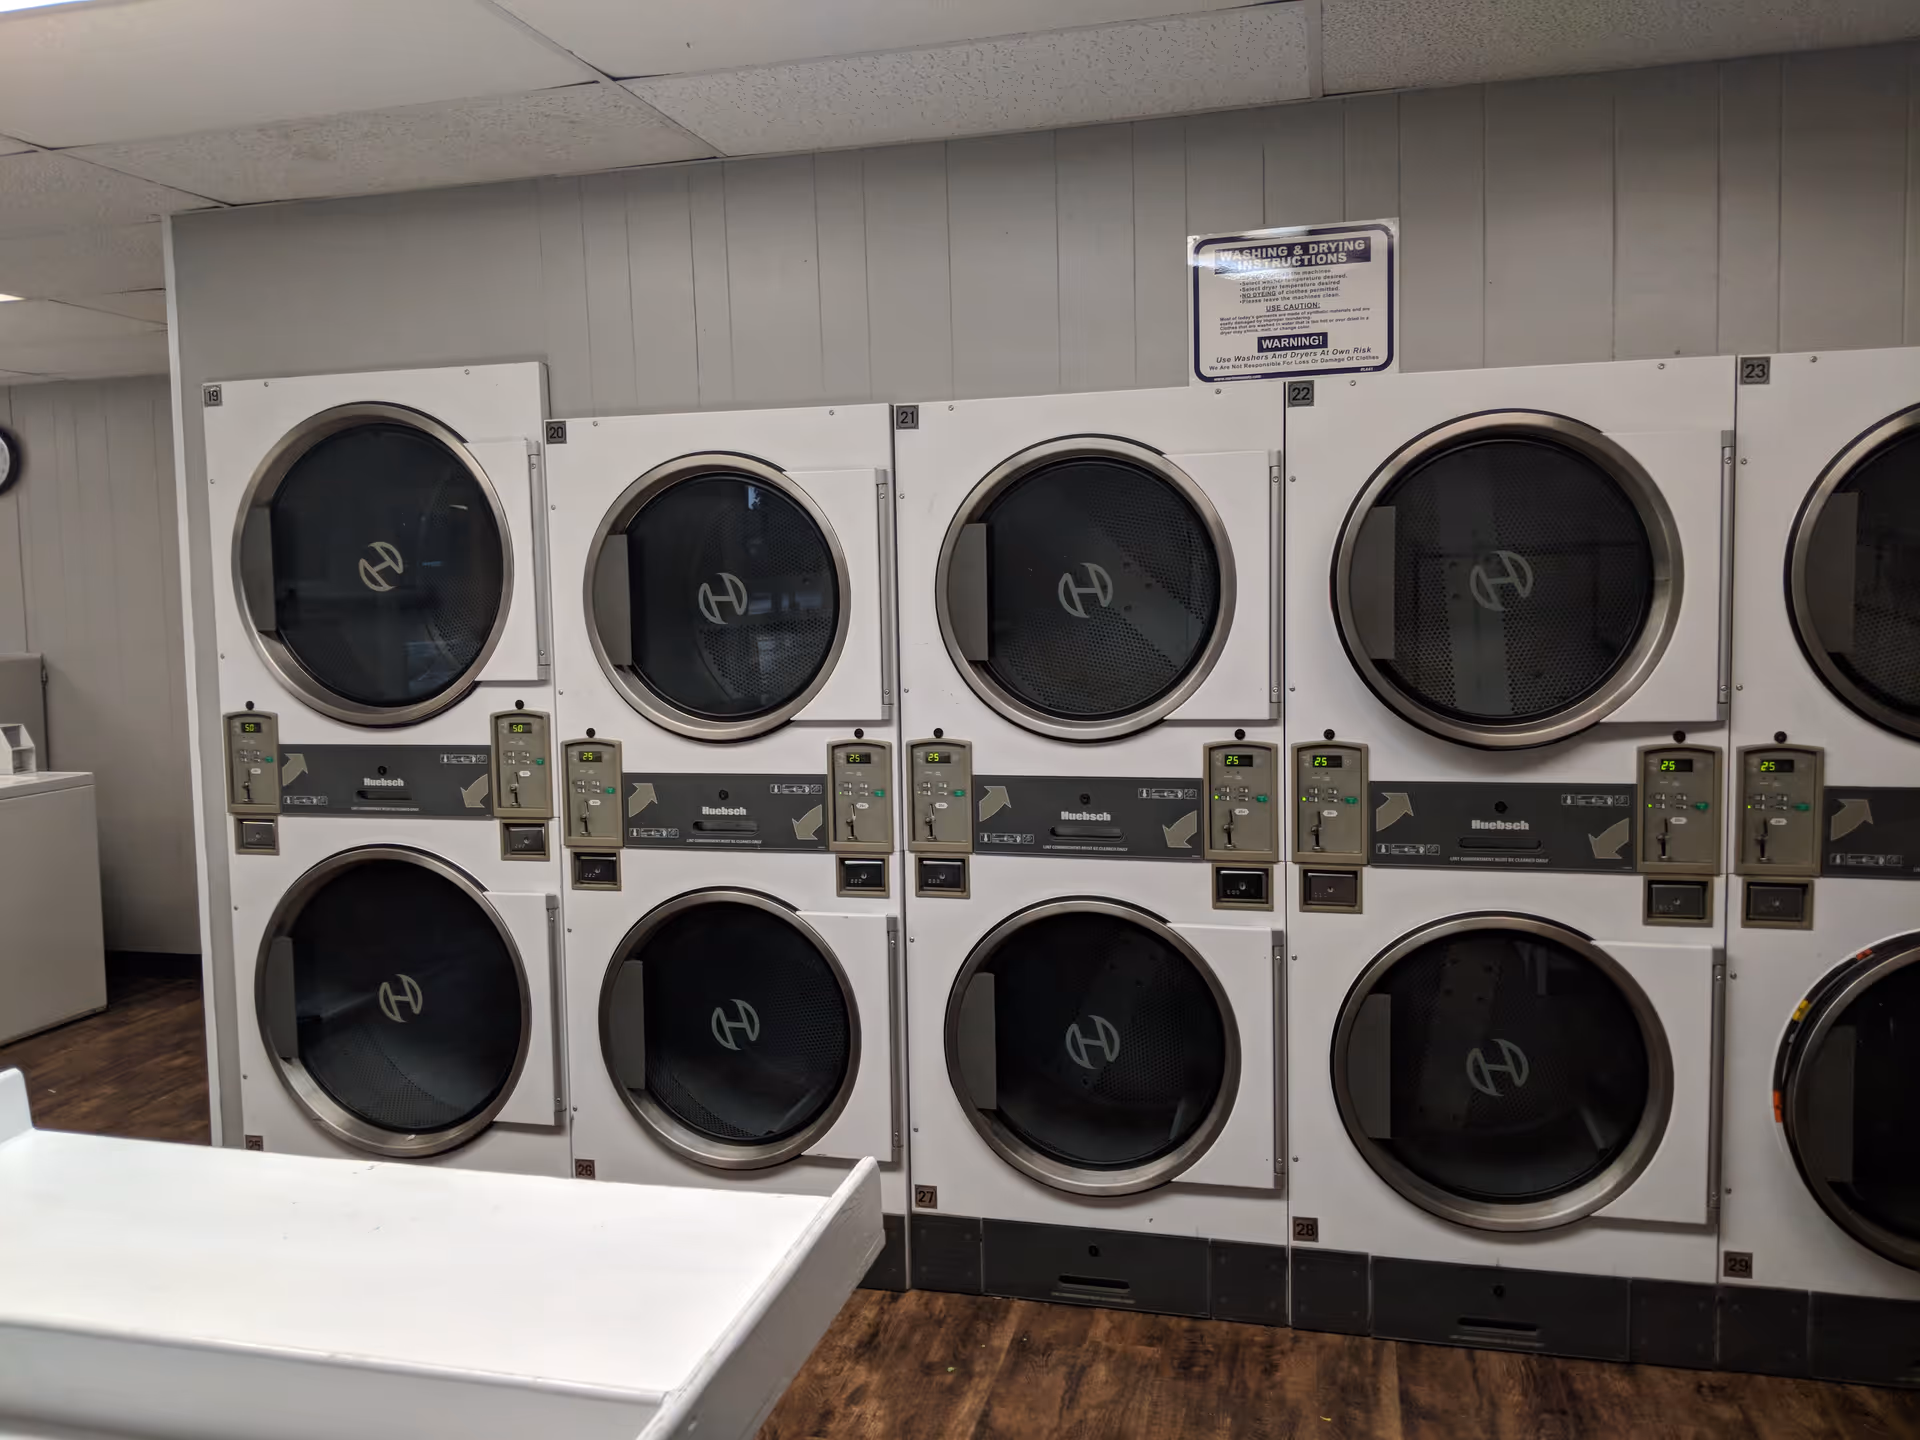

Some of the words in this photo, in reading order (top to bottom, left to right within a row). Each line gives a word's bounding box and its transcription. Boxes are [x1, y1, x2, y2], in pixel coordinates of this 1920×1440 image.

[1220, 246, 1288, 261] WASHING
[1293, 245, 1303, 255] &
[1309, 240, 1365, 254] DRYING
[1238, 252, 1348, 270] INSTRUCTIONS
[1280, 281, 1316, 289] temperature
[1265, 304, 1281, 312] USE
[1283, 302, 1321, 311] CAUTION:
[1262, 336, 1323, 349] WARNING!
[1234, 354, 1269, 362] Washers
[1290, 350, 1318, 359] Dryers
[1332, 348, 1350, 356] Own
[1353, 346, 1372, 354] Risk
[1243, 361, 1281, 369] Responsible
[1745, 363, 1766, 378] 23
[207, 390, 219, 402] 19
[1292, 387, 1310, 401] 22
[900, 411, 915, 424] 21
[549, 426, 563, 439] 20
[512, 724, 523, 732] 50
[582, 752, 593, 760] 25
[849, 754, 860, 762] 25
[928, 753, 939, 761] 25
[1226, 756, 1238, 765] 25
[1314, 757, 1327, 766] 25
[1660, 760, 1675, 770] 25
[1760, 761, 1775, 772] 25
[363, 777, 404, 787] Huebsch
[701, 806, 747, 815] Huebsch
[1060, 811, 1111, 821] Huebsch
[1471, 819, 1530, 831] Huebsch
[578, 1164, 592, 1176] 26
[918, 1190, 934, 1204] 27
[1296, 1223, 1315, 1237] 28
[1728, 1258, 1748, 1273] 29
